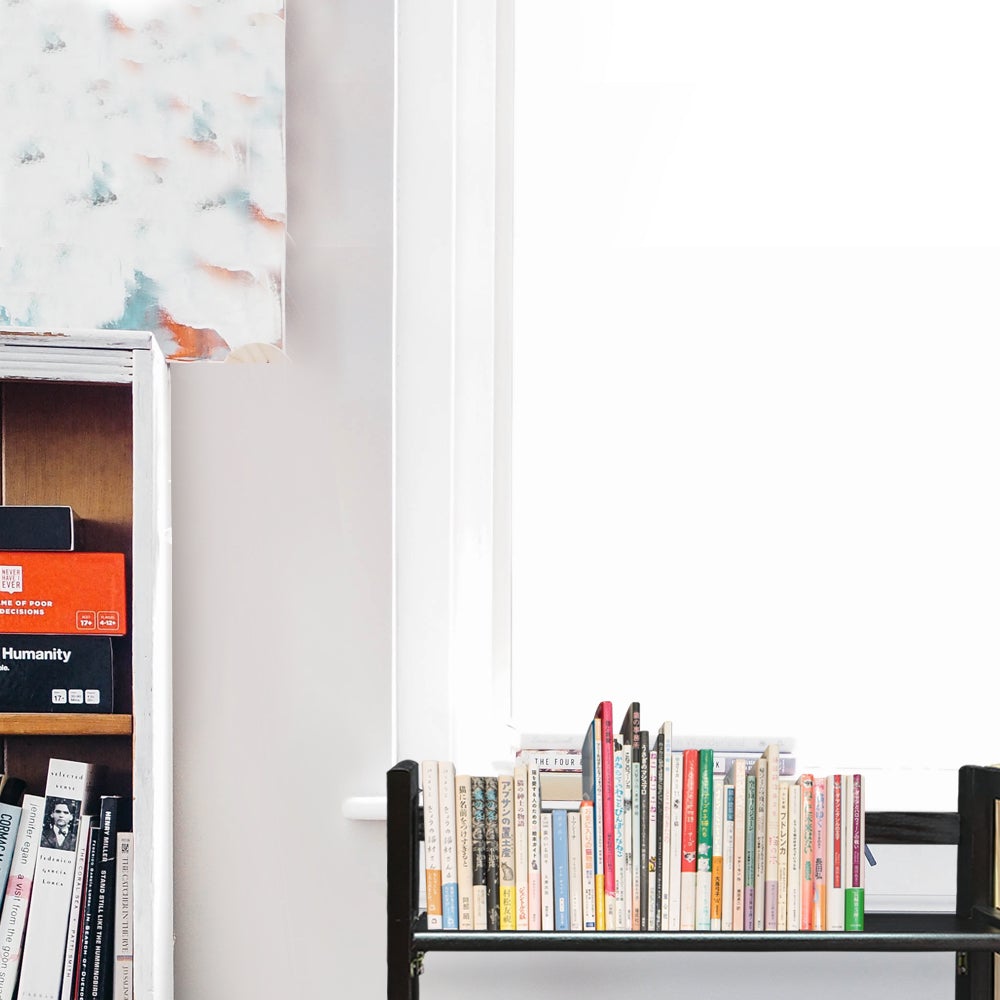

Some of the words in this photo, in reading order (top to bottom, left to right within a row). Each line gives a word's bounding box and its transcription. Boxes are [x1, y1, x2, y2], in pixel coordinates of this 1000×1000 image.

[2, 648, 71, 663] Humanity
[535, 758, 549, 766] THE
[554, 758, 575, 766] FOUR
[51, 771, 84, 781] selected
[28, 803, 38, 839] jennifer
[104, 810, 112, 836] HENRY
[501, 781, 511, 858] アブサンの置土産
[20, 842, 31, 865] egan
[102, 836, 110, 862] MILLER
[121, 858, 129, 872] THE
[13, 881, 23, 901] visit
[99, 870, 107, 893] STAND
[121, 874, 129, 911] CATCHER
[10, 901, 20, 926] from
[97, 895, 105, 914] STILL
[5, 927, 15, 943] the
[121, 921, 129, 937] THE
[121, 937, 129, 953] RYE
[1, 946, 11, 969] goon
[91, 945, 101, 997] HUMMINGBIRD
